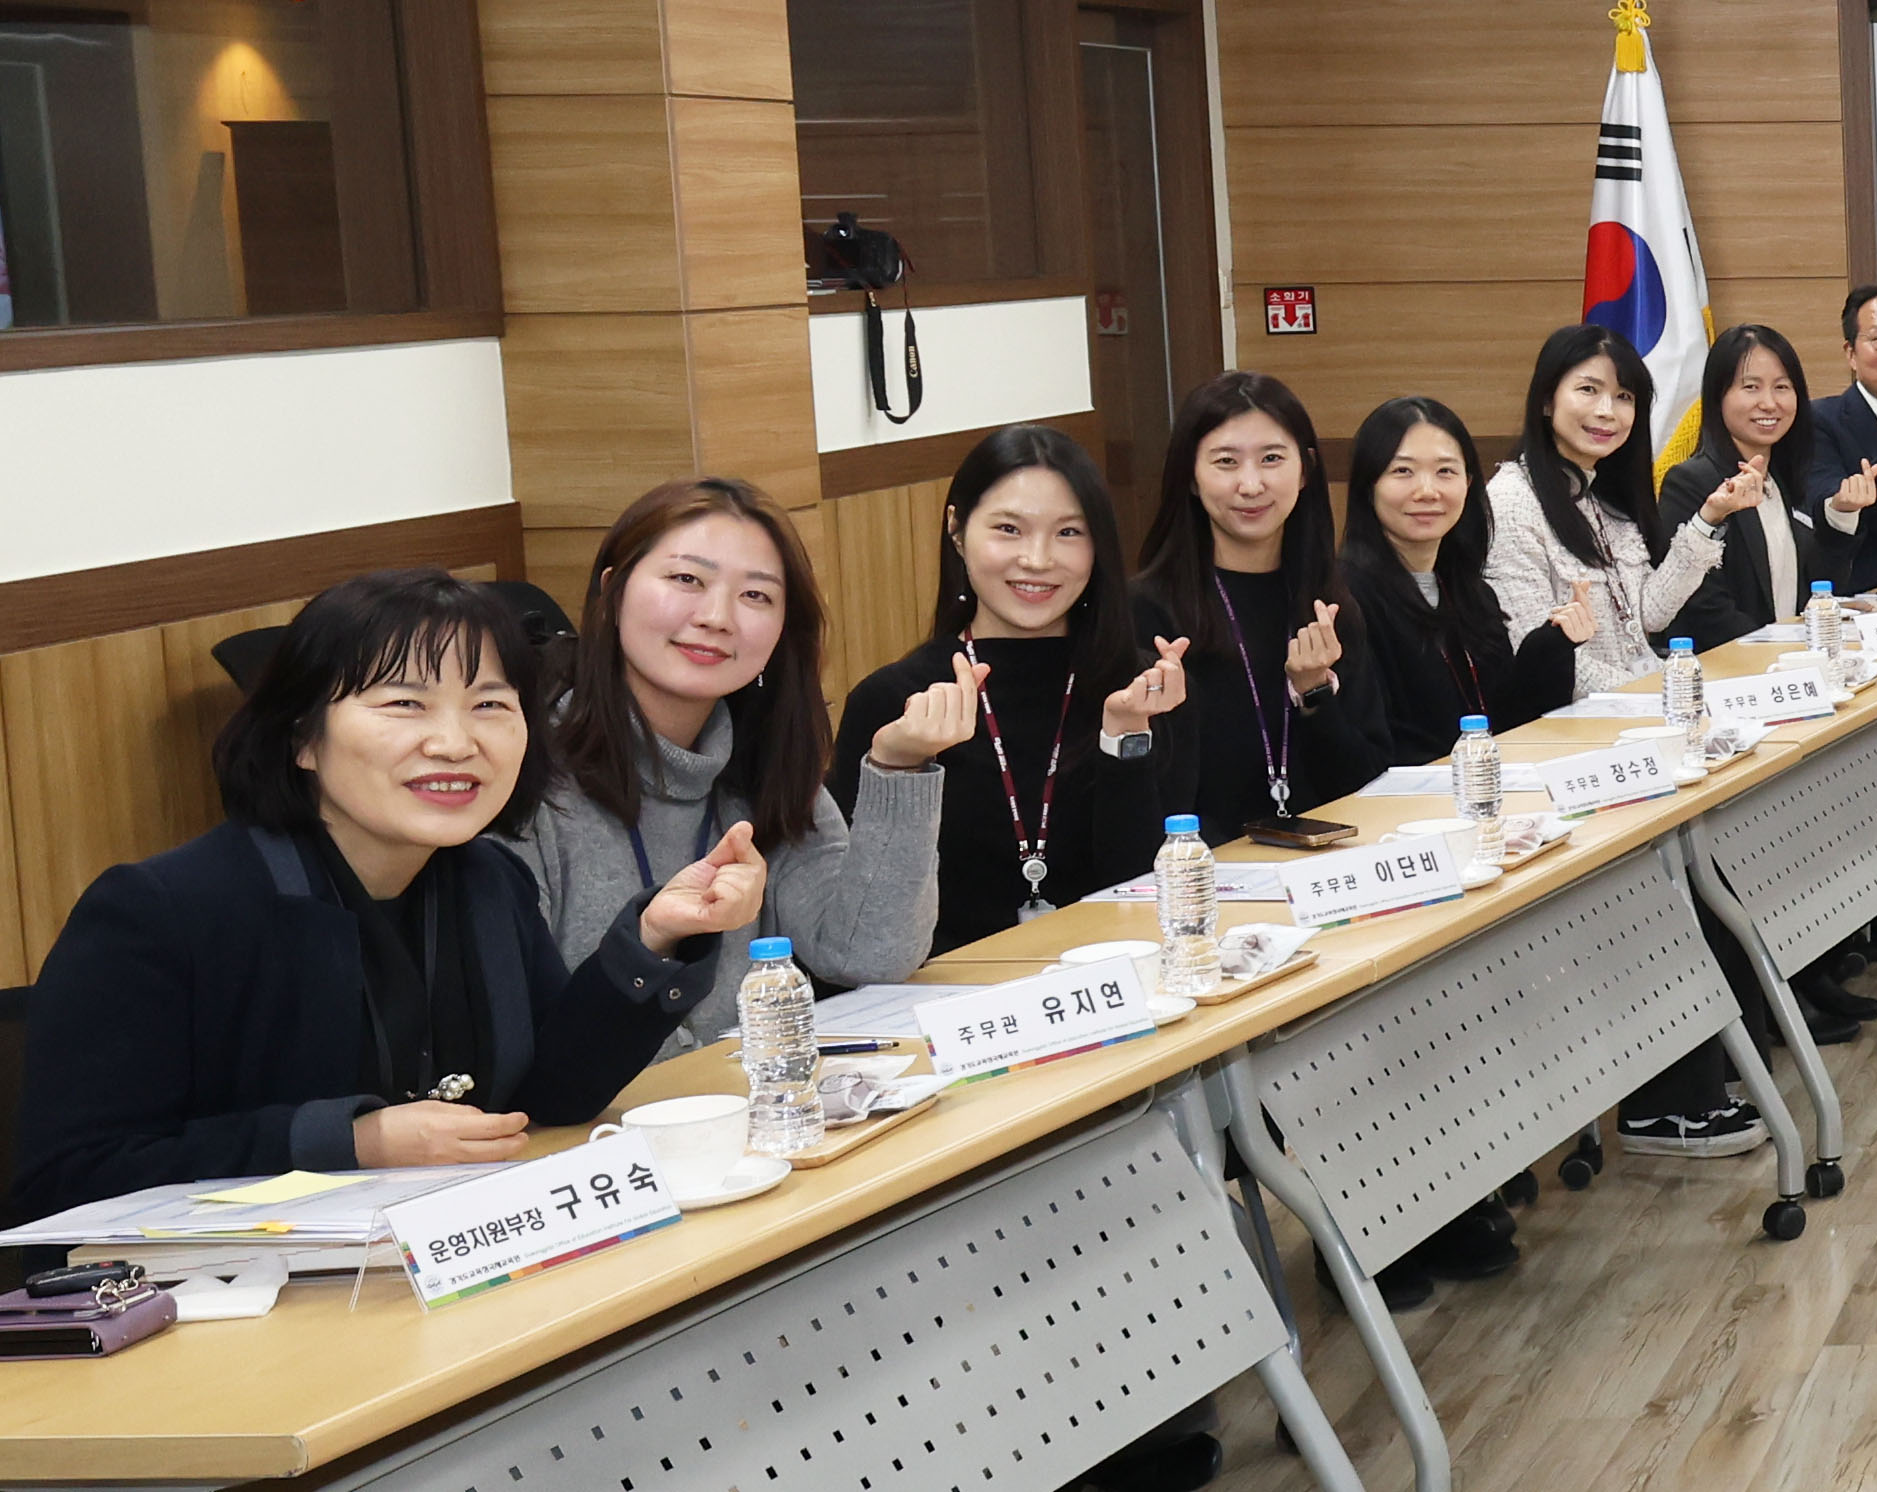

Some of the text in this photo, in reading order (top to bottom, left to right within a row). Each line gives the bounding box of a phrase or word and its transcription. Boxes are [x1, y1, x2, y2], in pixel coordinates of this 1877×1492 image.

[908, 345, 919, 378] Canon
[1311, 874, 1358, 898] 주무관
[1375, 850, 1440, 883] 이단비
[958, 1014, 1019, 1046] 주무관
[1042, 980, 1125, 1025] 유지연
[428, 1207, 546, 1264] 운영지원부장
